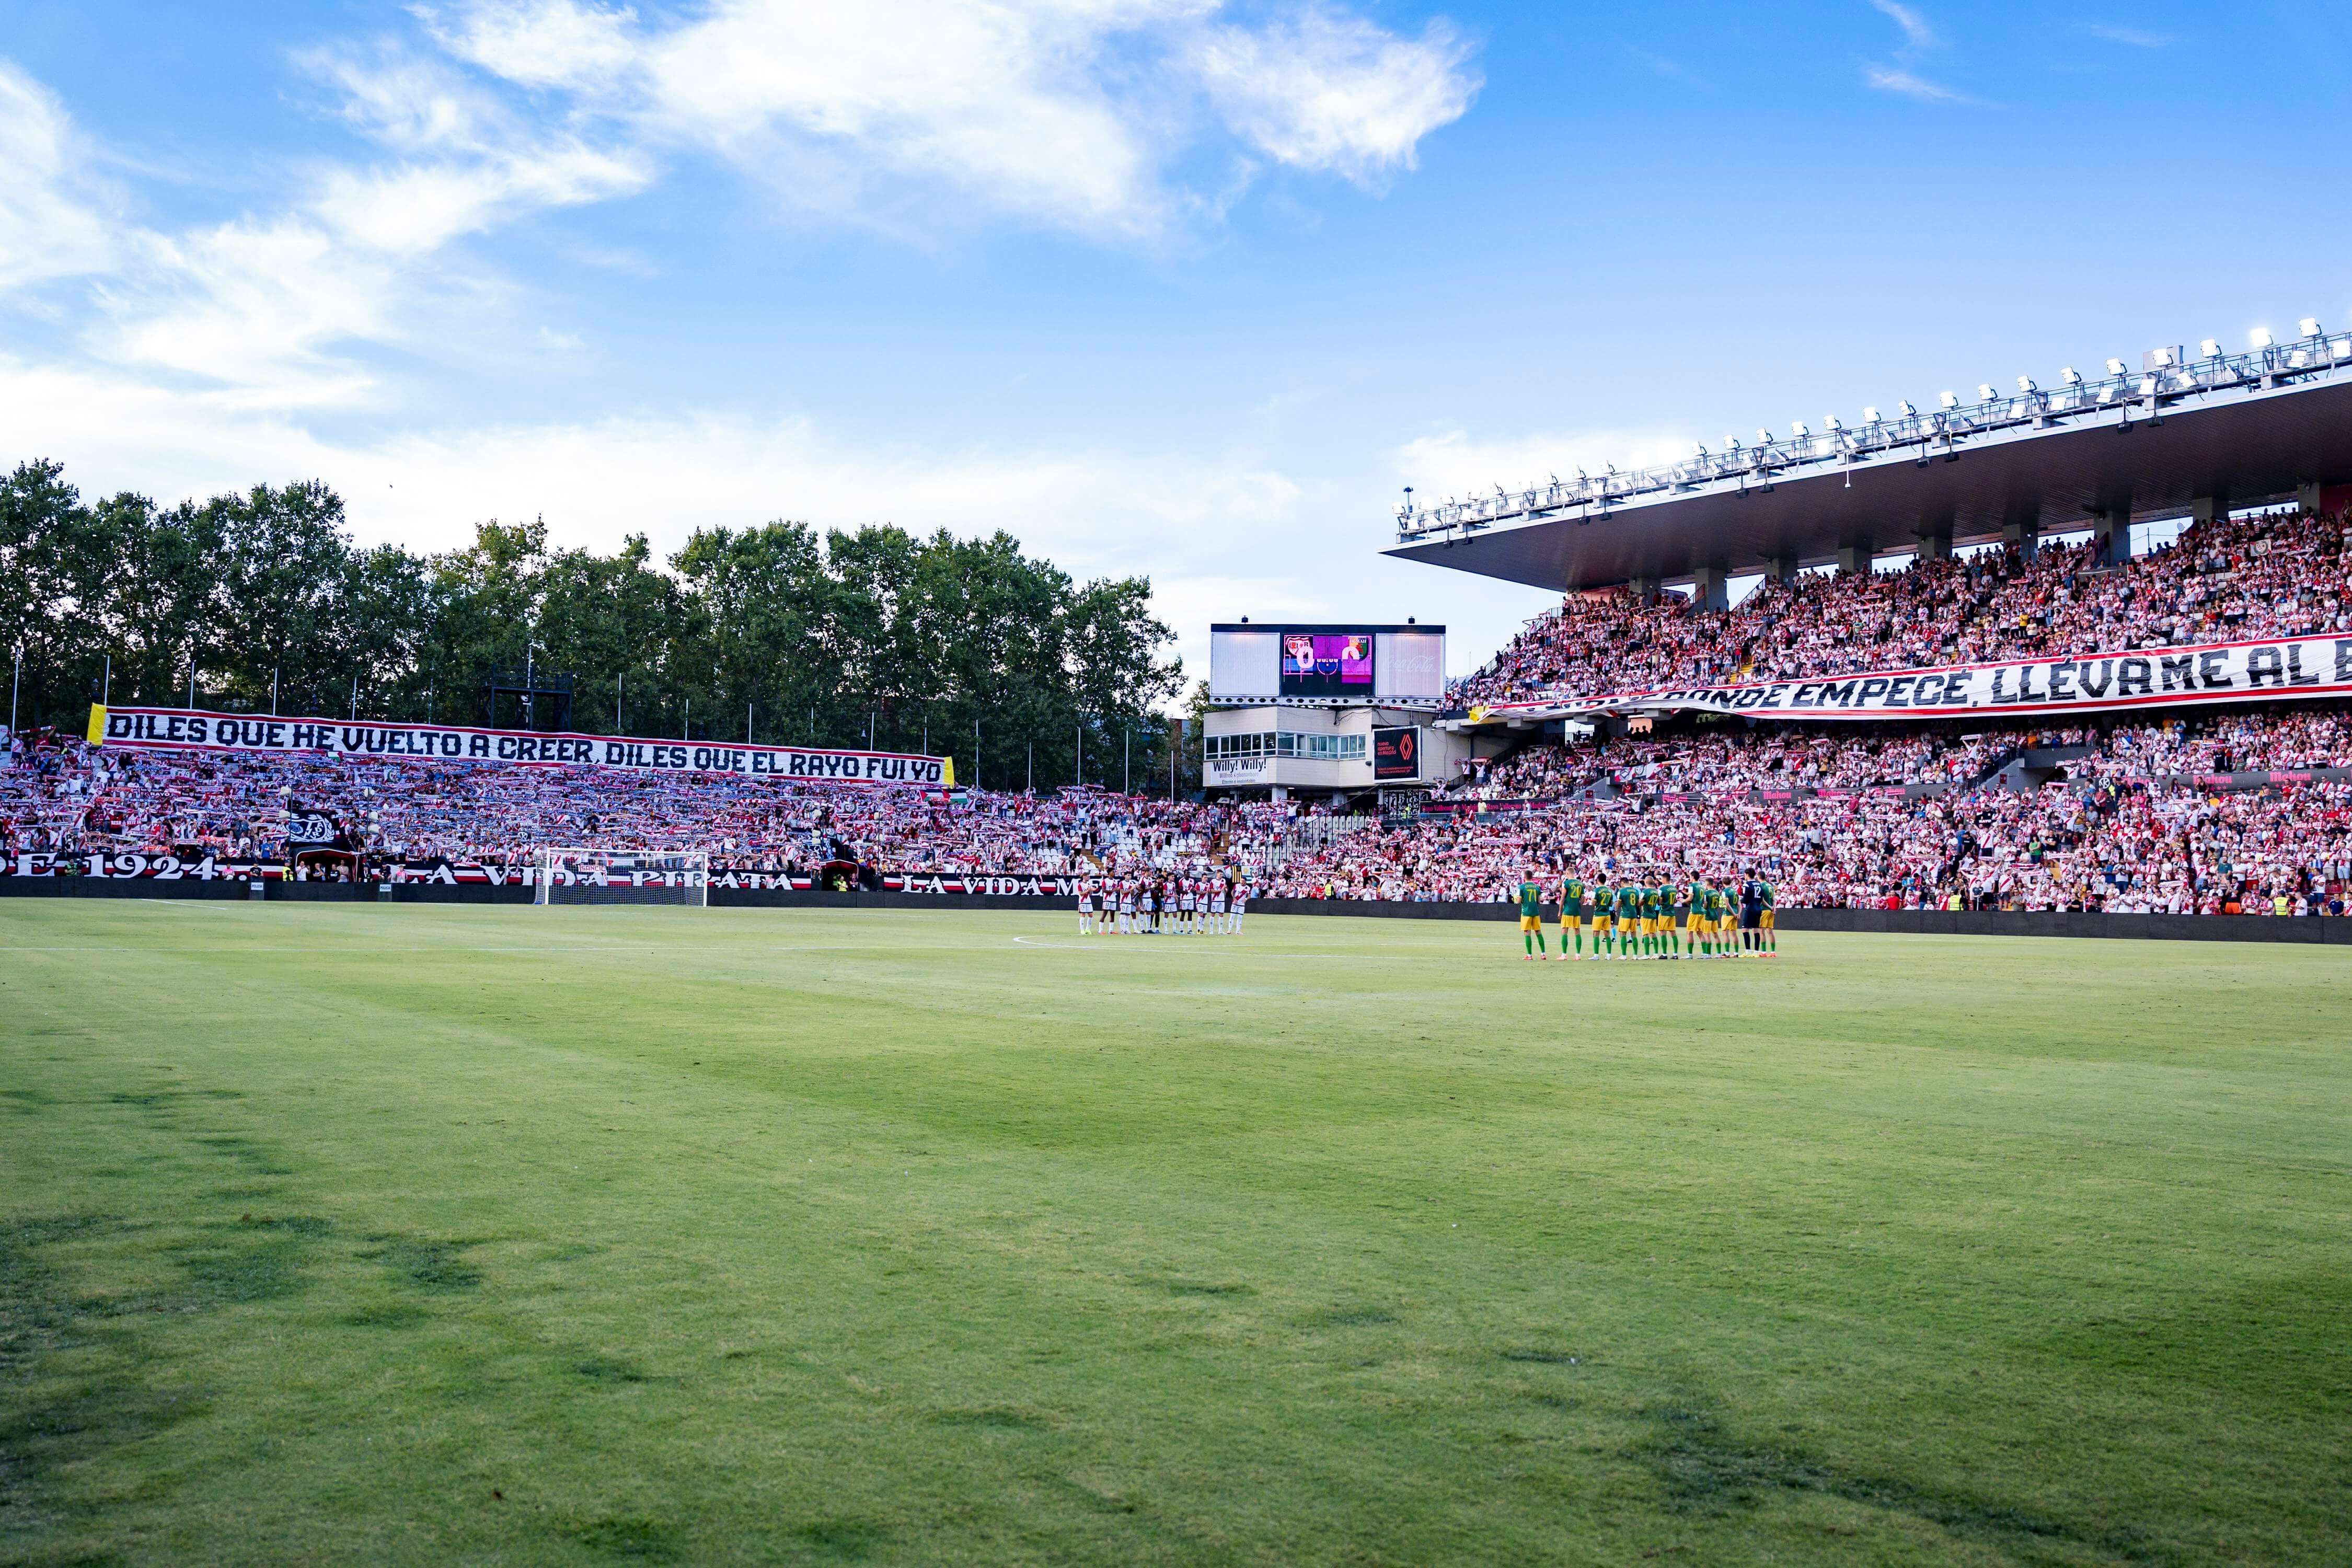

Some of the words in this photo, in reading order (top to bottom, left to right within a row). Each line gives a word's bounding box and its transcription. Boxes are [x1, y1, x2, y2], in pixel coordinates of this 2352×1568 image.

[1991, 650, 2233, 703] LLÉVAME
[2247, 644, 2319, 687] AL
[107, 714, 207, 743] DILES
[216, 720, 286, 747] QUE
[292, 724, 335, 750] HE
[341, 728, 462, 756] VUELTO
[469, 734, 490, 757] A
[498, 737, 600, 764] CREER,
[605, 742, 687, 768] DILES
[694, 747, 746, 772] QUE
[752, 752, 783, 774] EL
[789, 754, 860, 777] RAYO
[866, 758, 906, 780] FUI
[911, 762, 941, 782] YO
[1213, 759, 1238, 774] Willy!
[1241, 758, 1266, 772] Willy!
[2270, 771, 2311, 782] Mahou
[1763, 791, 1792, 799] Mahou
[482, 866, 608, 886] VIDA
[901, 875, 948, 894] LA
[963, 877, 1044, 895] VIDA
[1571, 885, 1582, 898] 20
[1526, 889, 1536, 902] 71
[1600, 892, 1611, 905] 27
[1669, 892, 1677, 905] 17
[1699, 888, 1704, 900] 9
[1754, 886, 1762, 898] 12
[1630, 893, 1636, 905] 8
[1648, 895, 1658, 906] 47
[1711, 895, 1719, 908] 15
